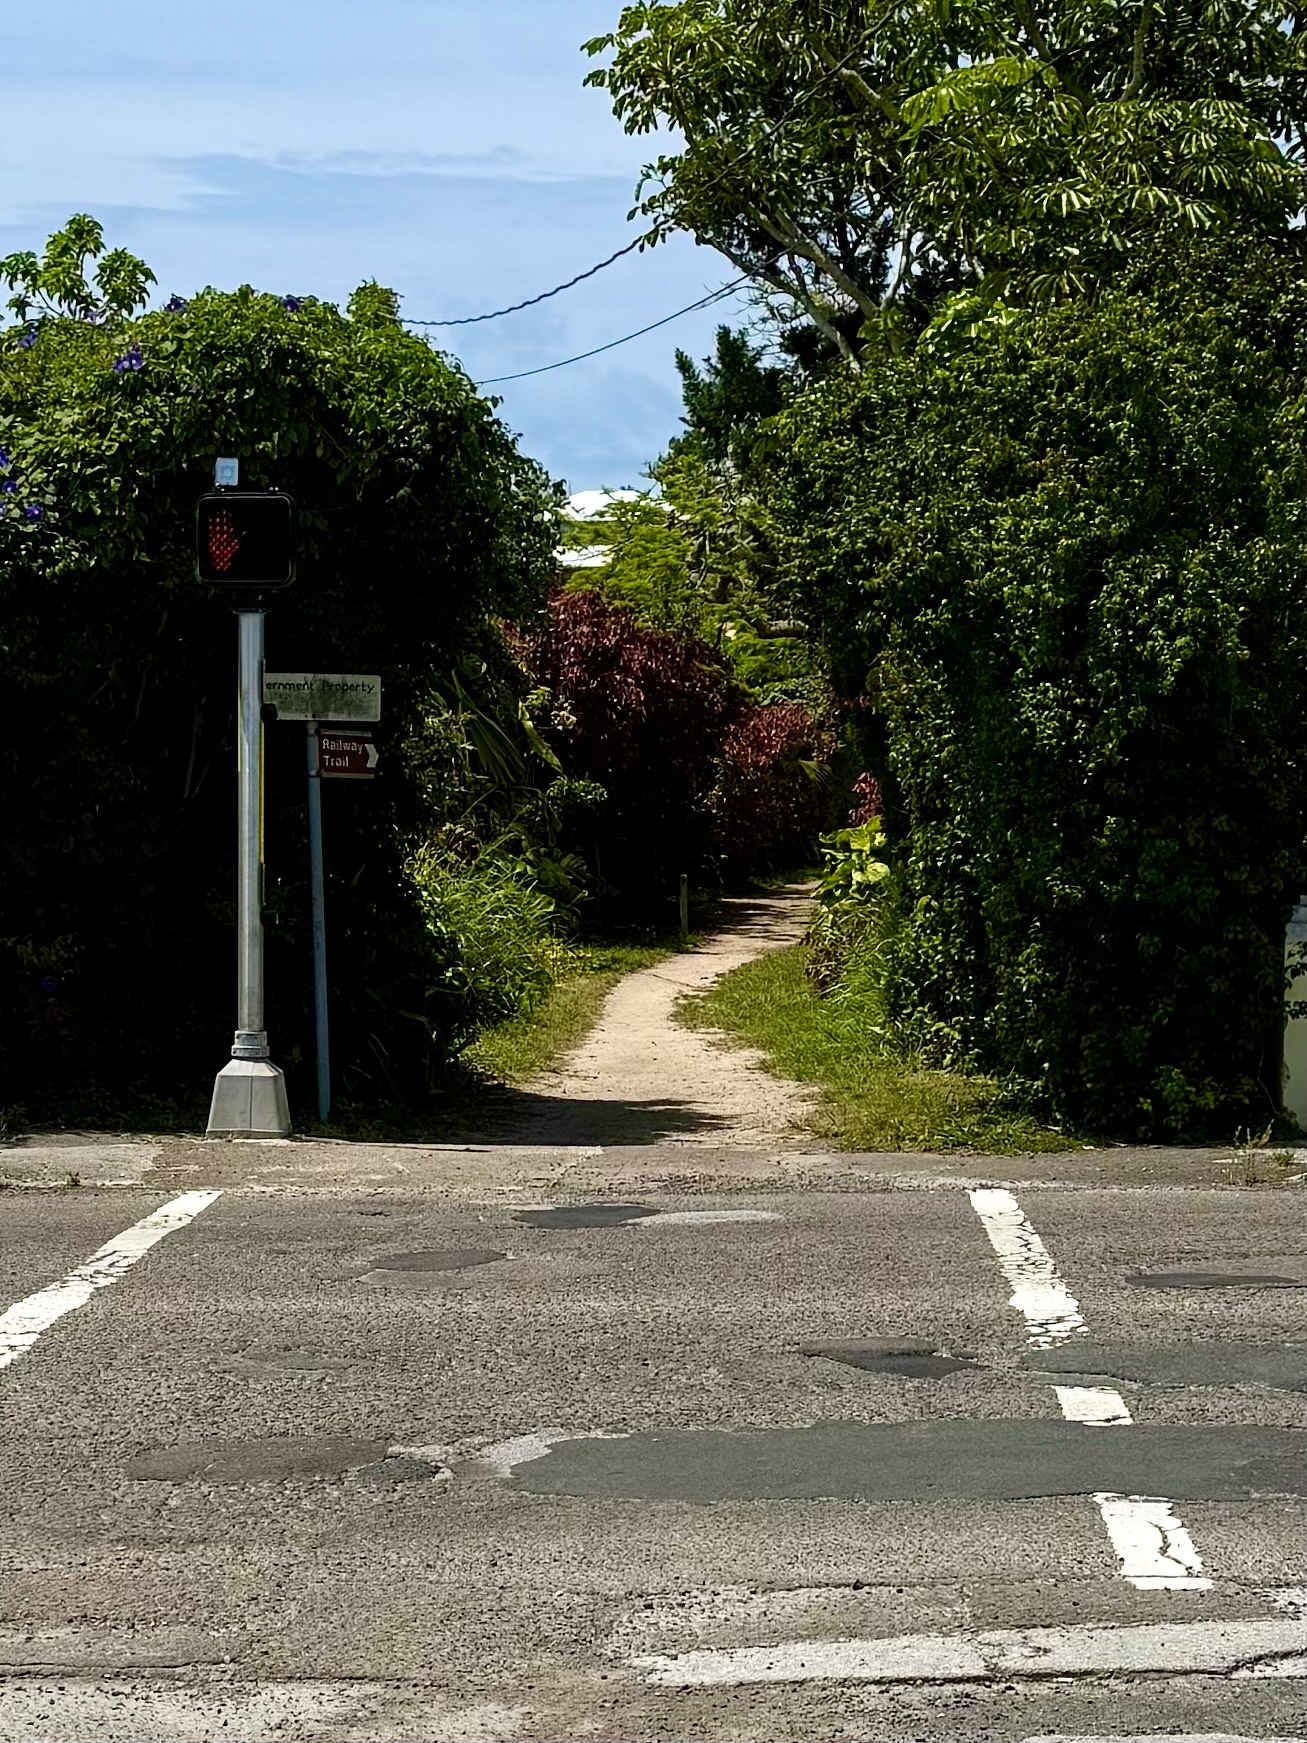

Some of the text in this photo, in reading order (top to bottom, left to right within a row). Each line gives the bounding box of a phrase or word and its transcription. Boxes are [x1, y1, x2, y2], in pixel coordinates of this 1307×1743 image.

[266, 680, 375, 694] ernment Property
[322, 738, 364, 755] Railway
[322, 755, 349, 768] Trail
